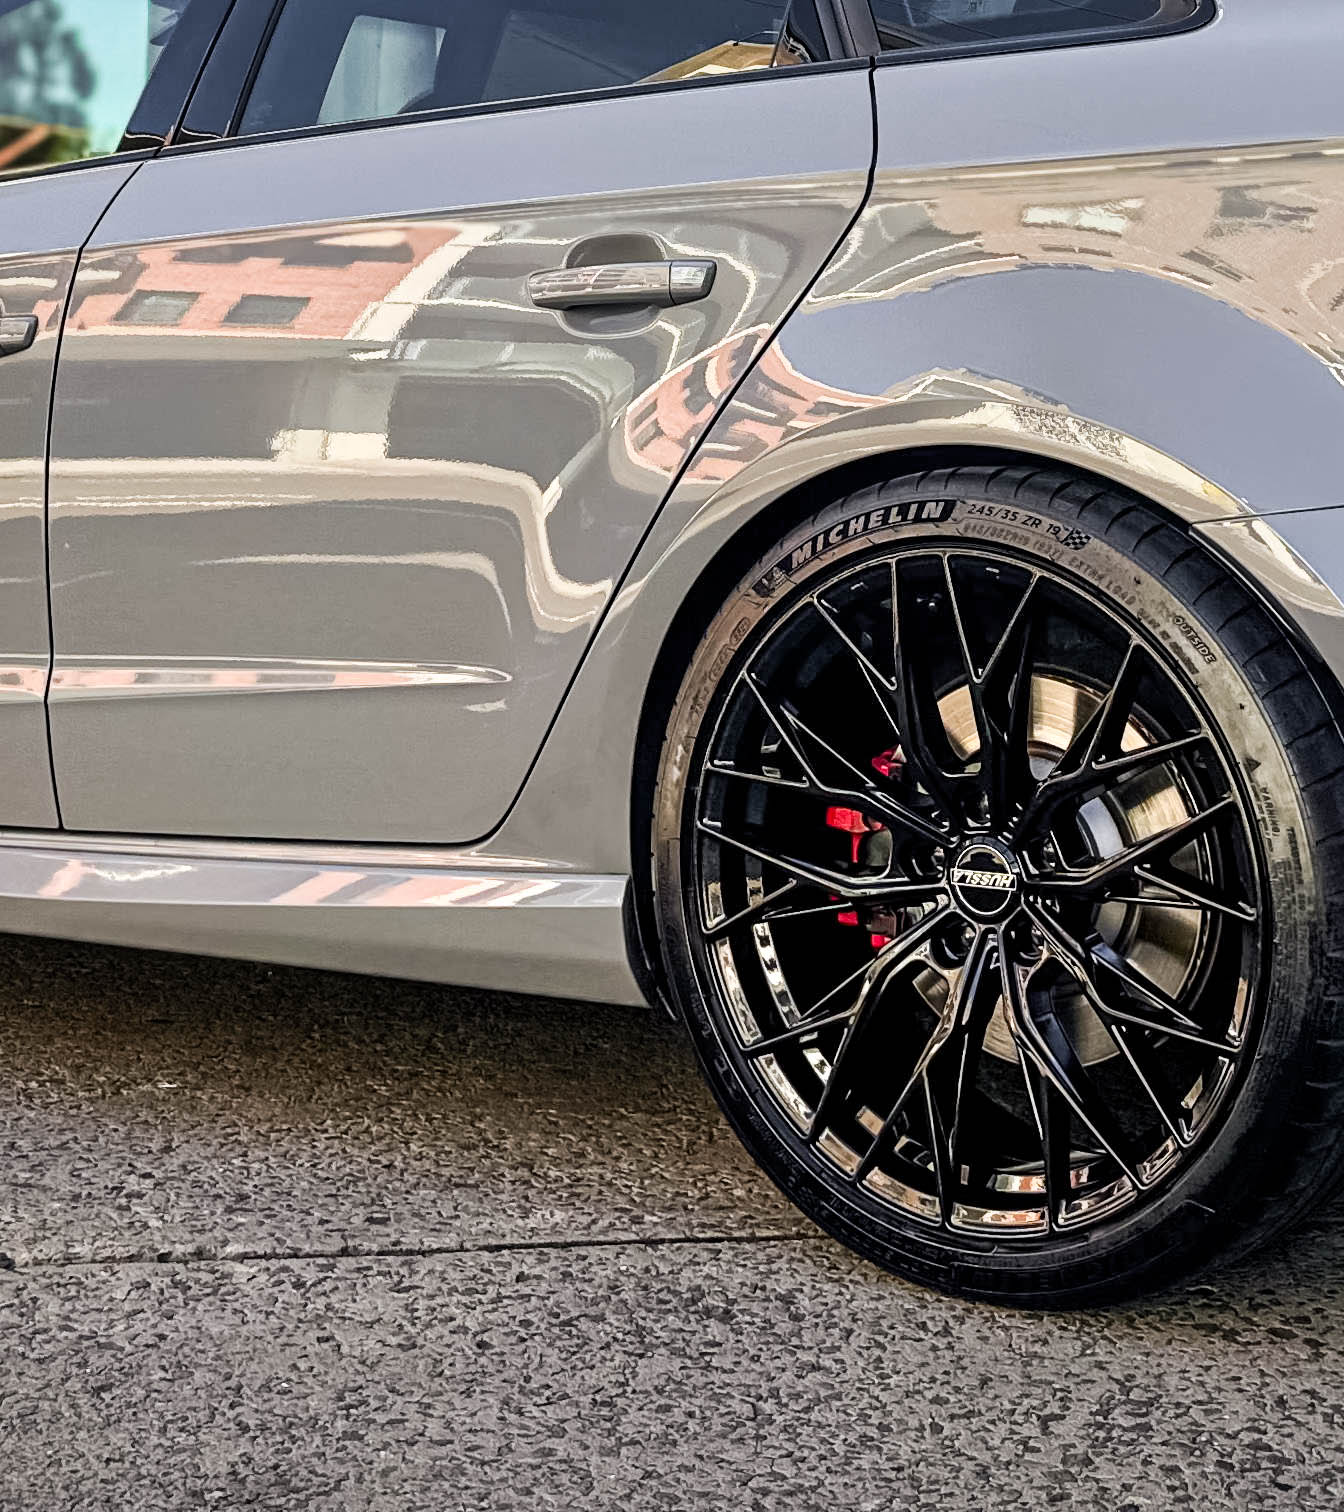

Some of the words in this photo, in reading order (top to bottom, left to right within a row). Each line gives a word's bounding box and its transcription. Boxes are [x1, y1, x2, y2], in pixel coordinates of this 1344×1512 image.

[790, 500, 947, 571] MICHELIN
[967, 503, 1020, 522] 245/35
[1021, 513, 1043, 529] ZR
[1046, 523, 1062, 537] 19
[1172, 614, 1218, 665] OUTSIDE
[952, 869, 1014, 888] HUSSLA
